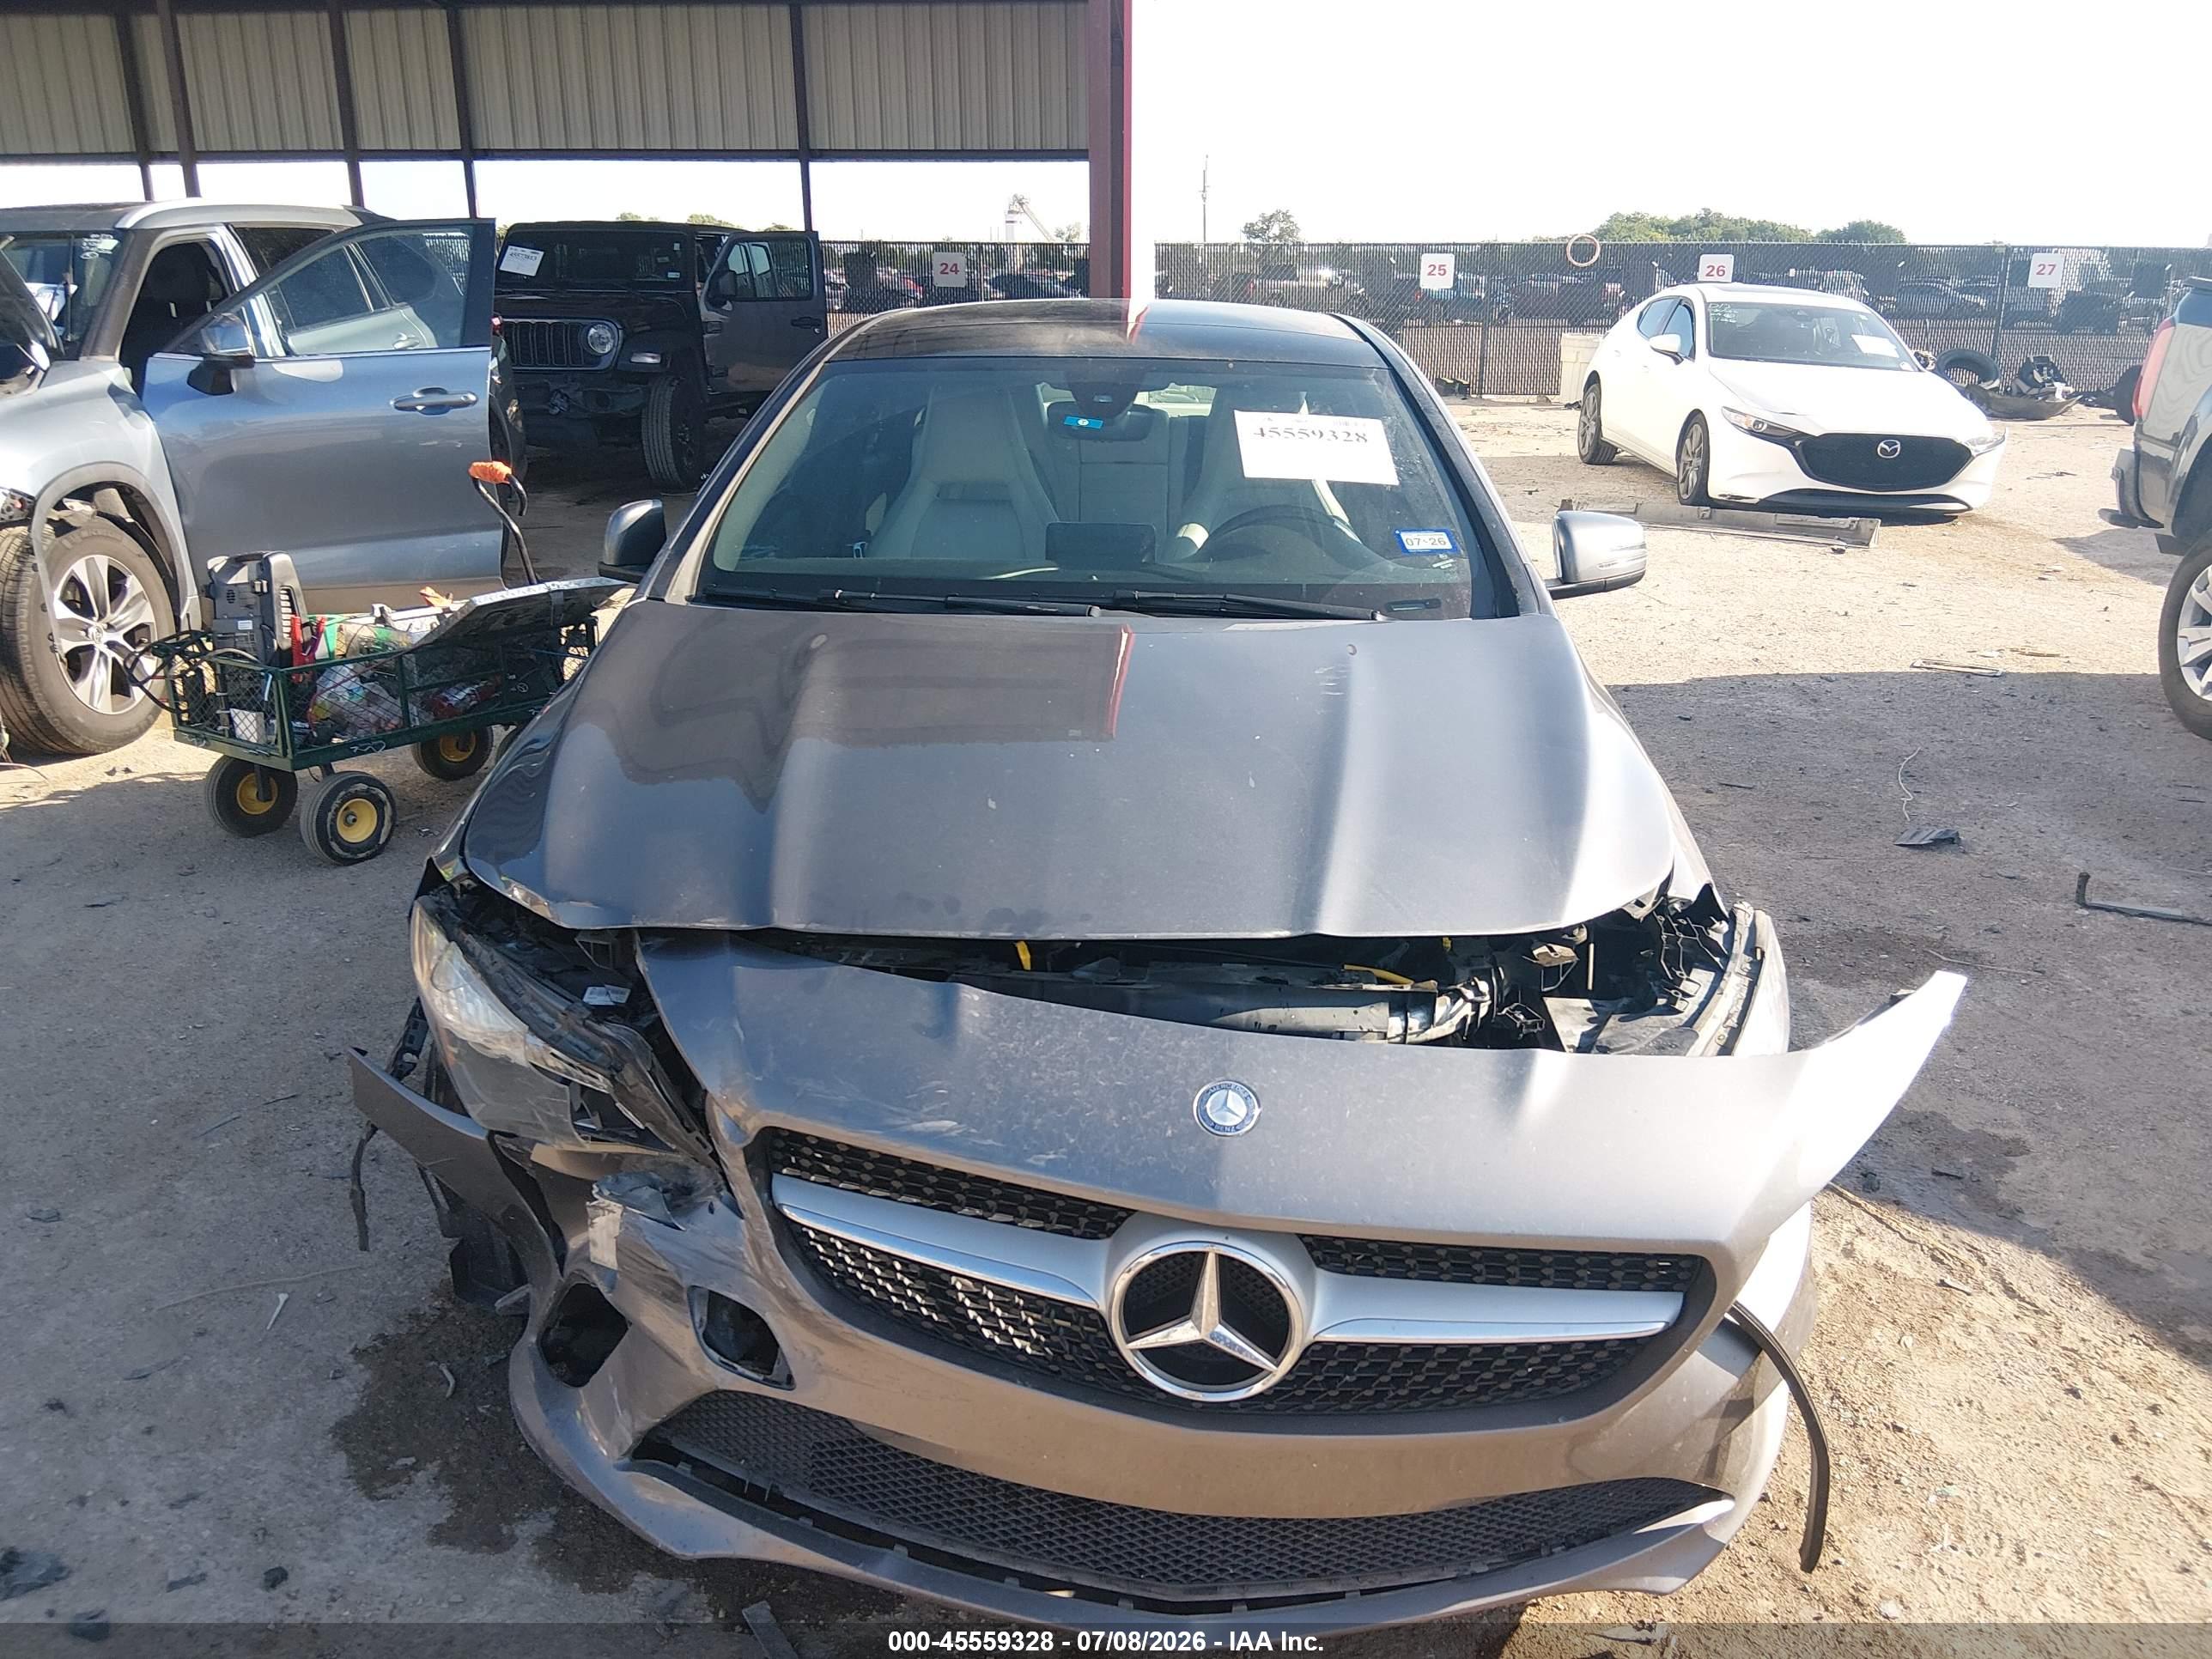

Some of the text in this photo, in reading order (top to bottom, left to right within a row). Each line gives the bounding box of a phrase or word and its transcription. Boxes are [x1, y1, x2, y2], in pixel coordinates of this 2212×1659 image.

[939, 262, 960, 275] 24
[1427, 264, 1447, 276] 25
[1705, 264, 1726, 277] 26
[2036, 263, 2057, 276] 27
[1254, 427, 1368, 443] 45559328
[1406, 537, 1446, 546] 07-26
